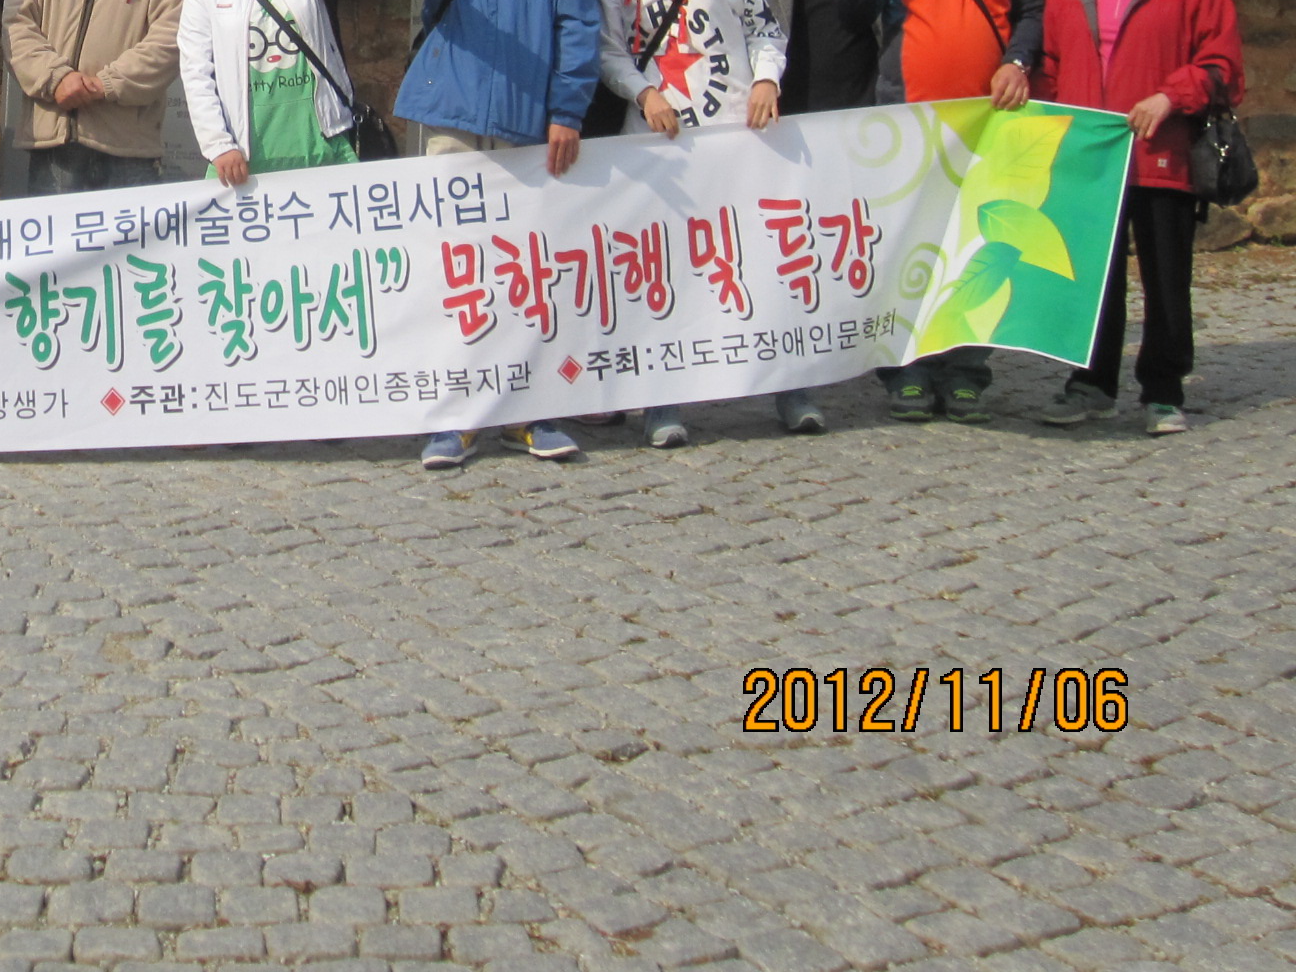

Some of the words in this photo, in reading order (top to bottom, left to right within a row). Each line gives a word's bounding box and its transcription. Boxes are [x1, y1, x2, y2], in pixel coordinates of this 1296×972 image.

[671, 8, 730, 128] STRIPE
[70, 189, 314, 253] 문화예술향수
[4, 253, 182, 372] 향기를
[441, 221, 674, 344] 문학기행
[687, 205, 753, 320] 및
[757, 197, 881, 313] 특강
